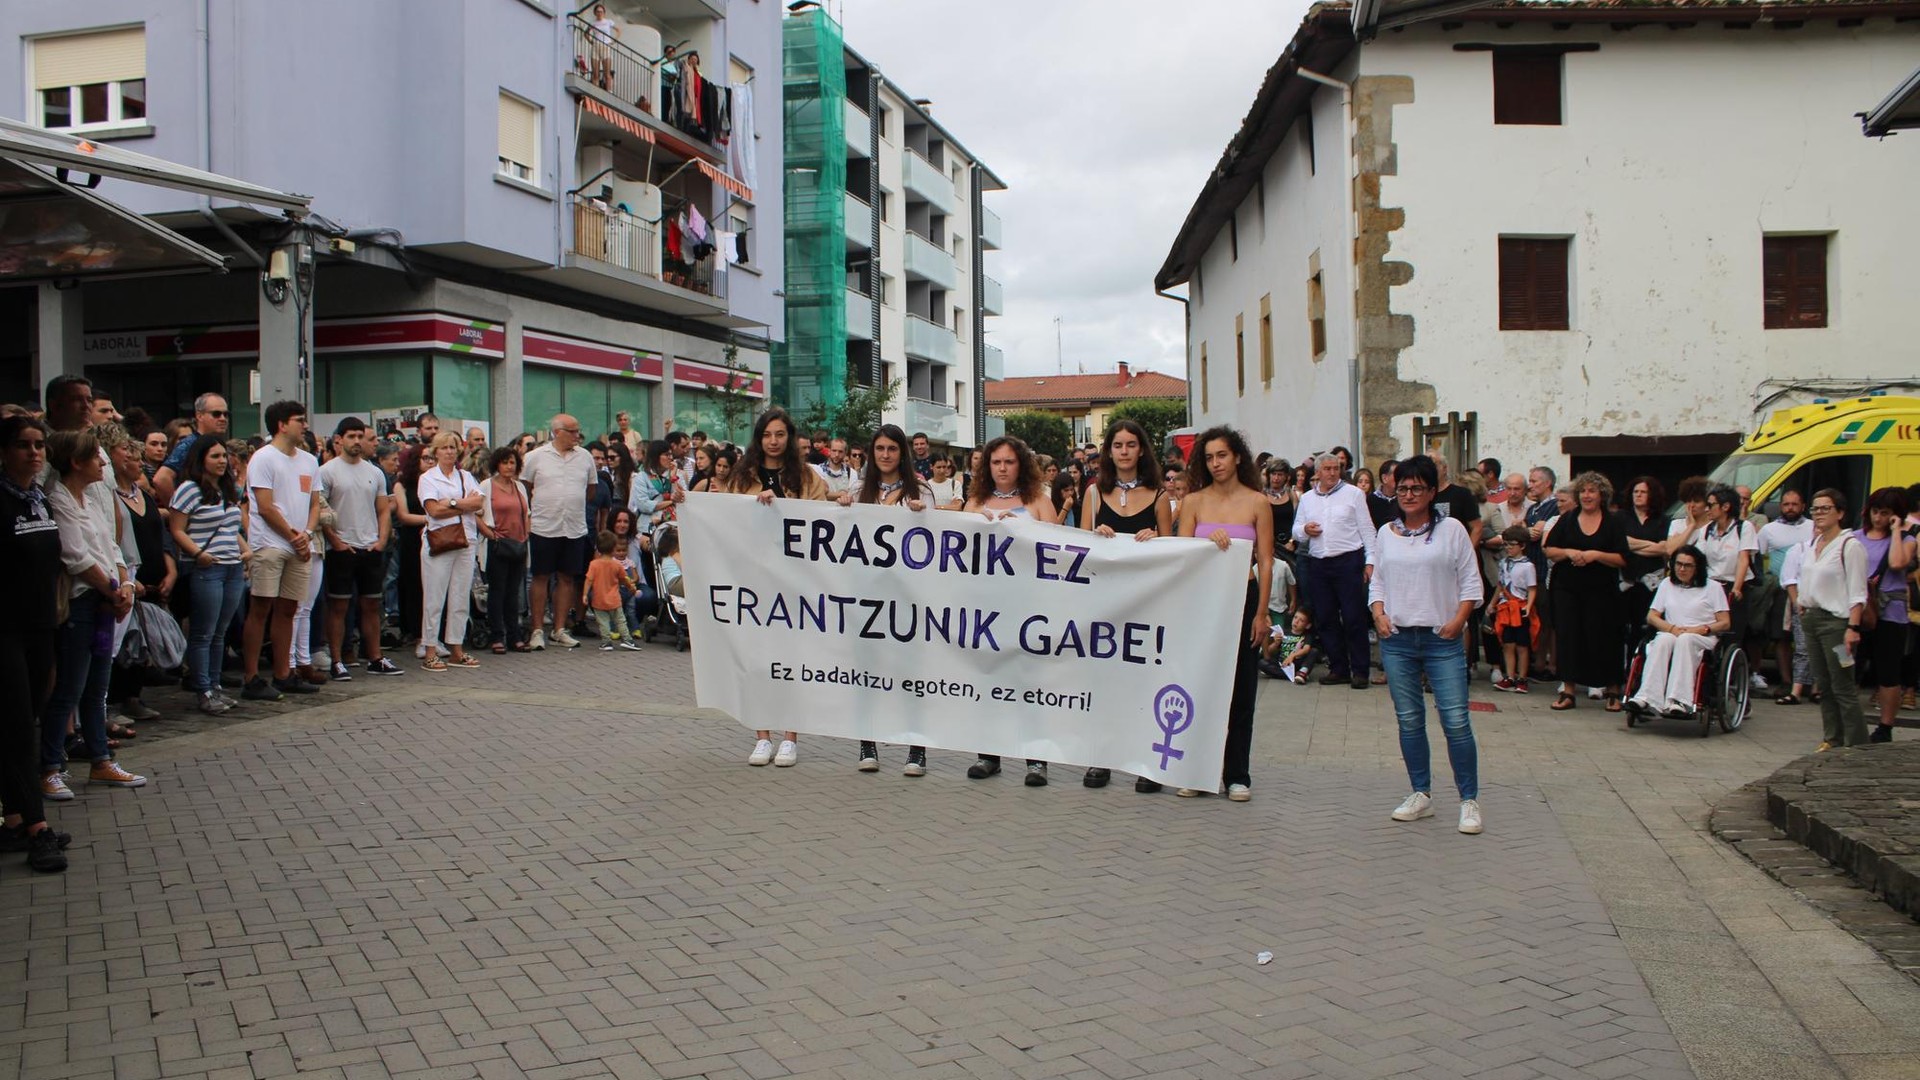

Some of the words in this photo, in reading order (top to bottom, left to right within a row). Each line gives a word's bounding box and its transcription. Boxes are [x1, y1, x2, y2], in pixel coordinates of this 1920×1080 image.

[84, 335, 141, 351] LABORAL
[783, 518, 1016, 576] ERASORIK
[1035, 541, 1091, 585] EZ
[709, 584, 1001, 652] ERANTZUNIK
[1018, 614, 1166, 666] GABE!
[770, 662, 795, 681] Ez
[801, 663, 893, 692] badakizu
[901, 678, 981, 702] egoten,
[991, 686, 1017, 702] ez
[1023, 688, 1092, 713] etorri!
